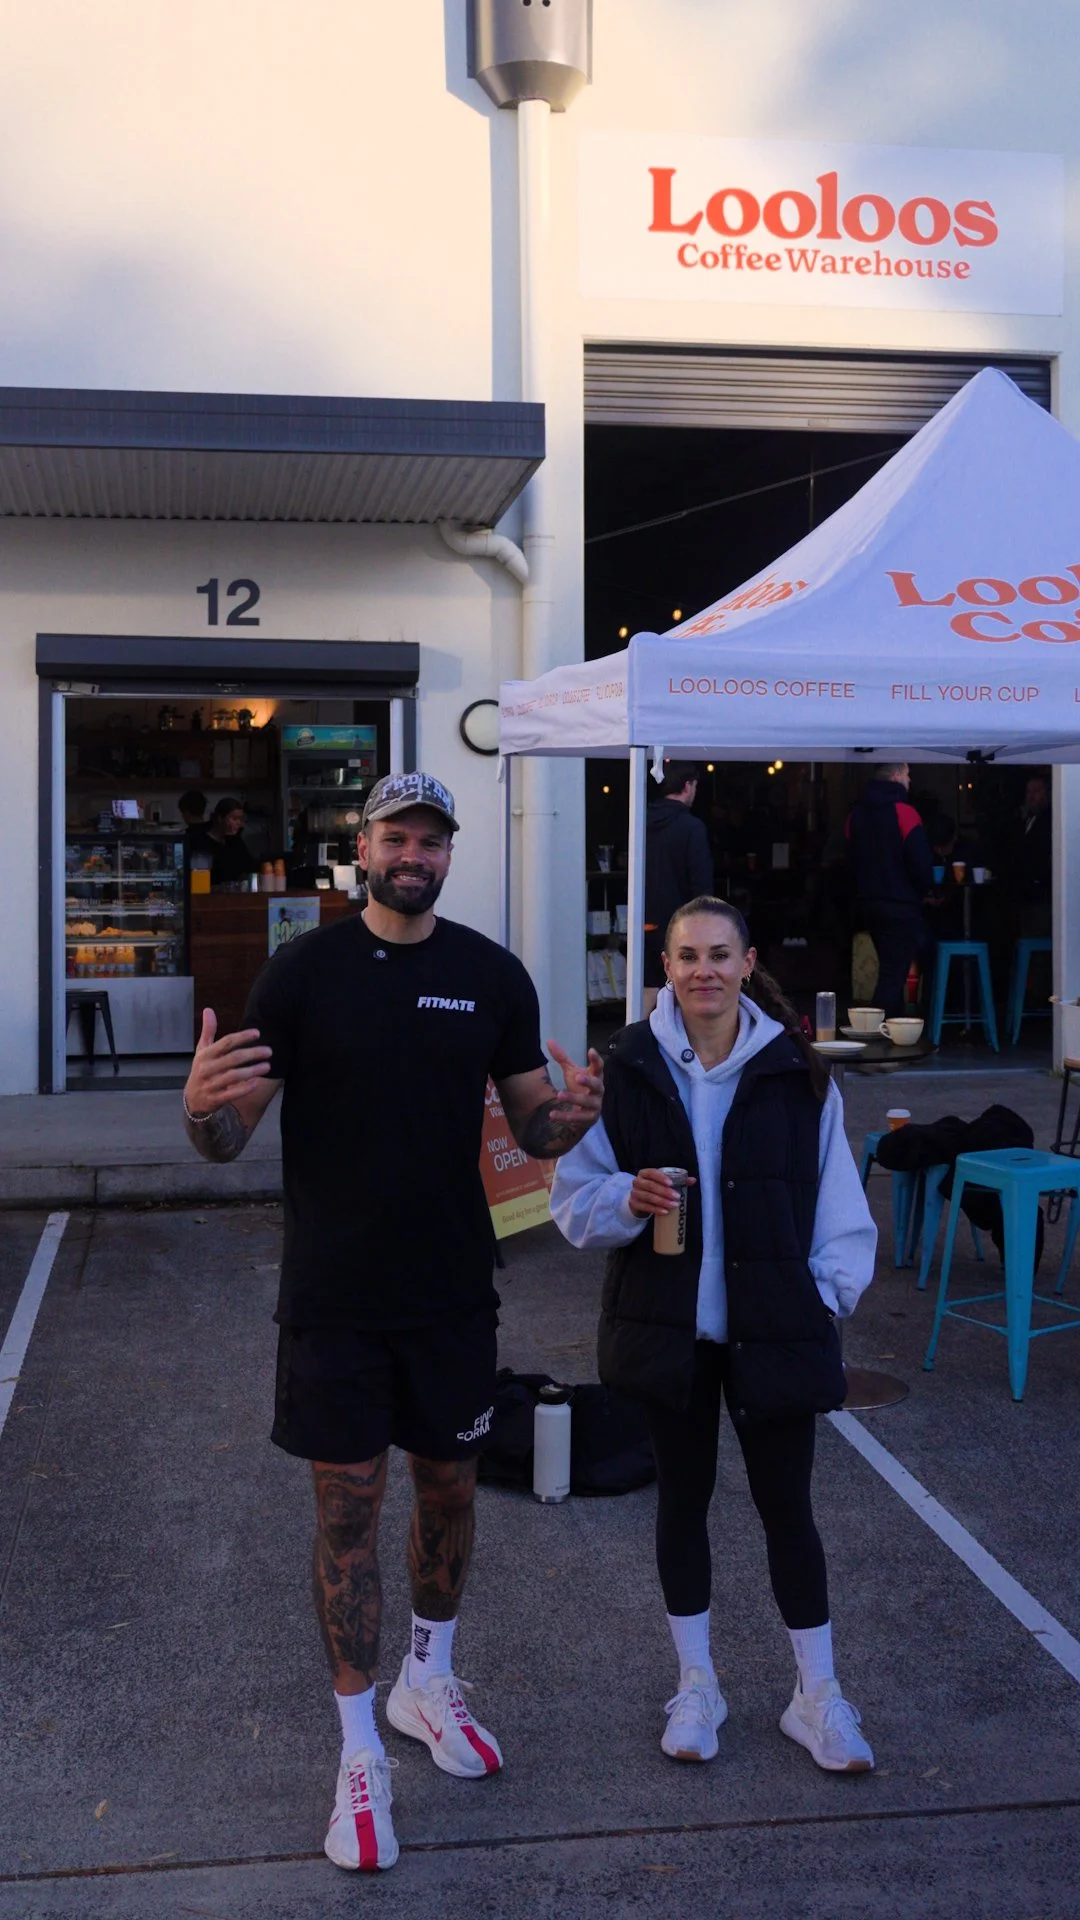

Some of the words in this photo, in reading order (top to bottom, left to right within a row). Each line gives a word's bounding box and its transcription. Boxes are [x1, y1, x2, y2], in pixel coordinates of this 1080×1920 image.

[648, 166, 998, 248] Looloos
[677, 243, 781, 271] Coffee
[785, 248, 971, 279] Warehouse
[196, 578, 261, 626] 12
[668, 677, 768, 695] LOOLOOS
[774, 679, 855, 698] COFFEE
[892, 684, 932, 701] FILL
[938, 685, 992, 702] YOUR
[998, 686, 1039, 703] CUP
[417, 996, 475, 1012] FITMATE
[487, 1136, 508, 1152] NOW
[494, 1148, 528, 1172] OPEN
